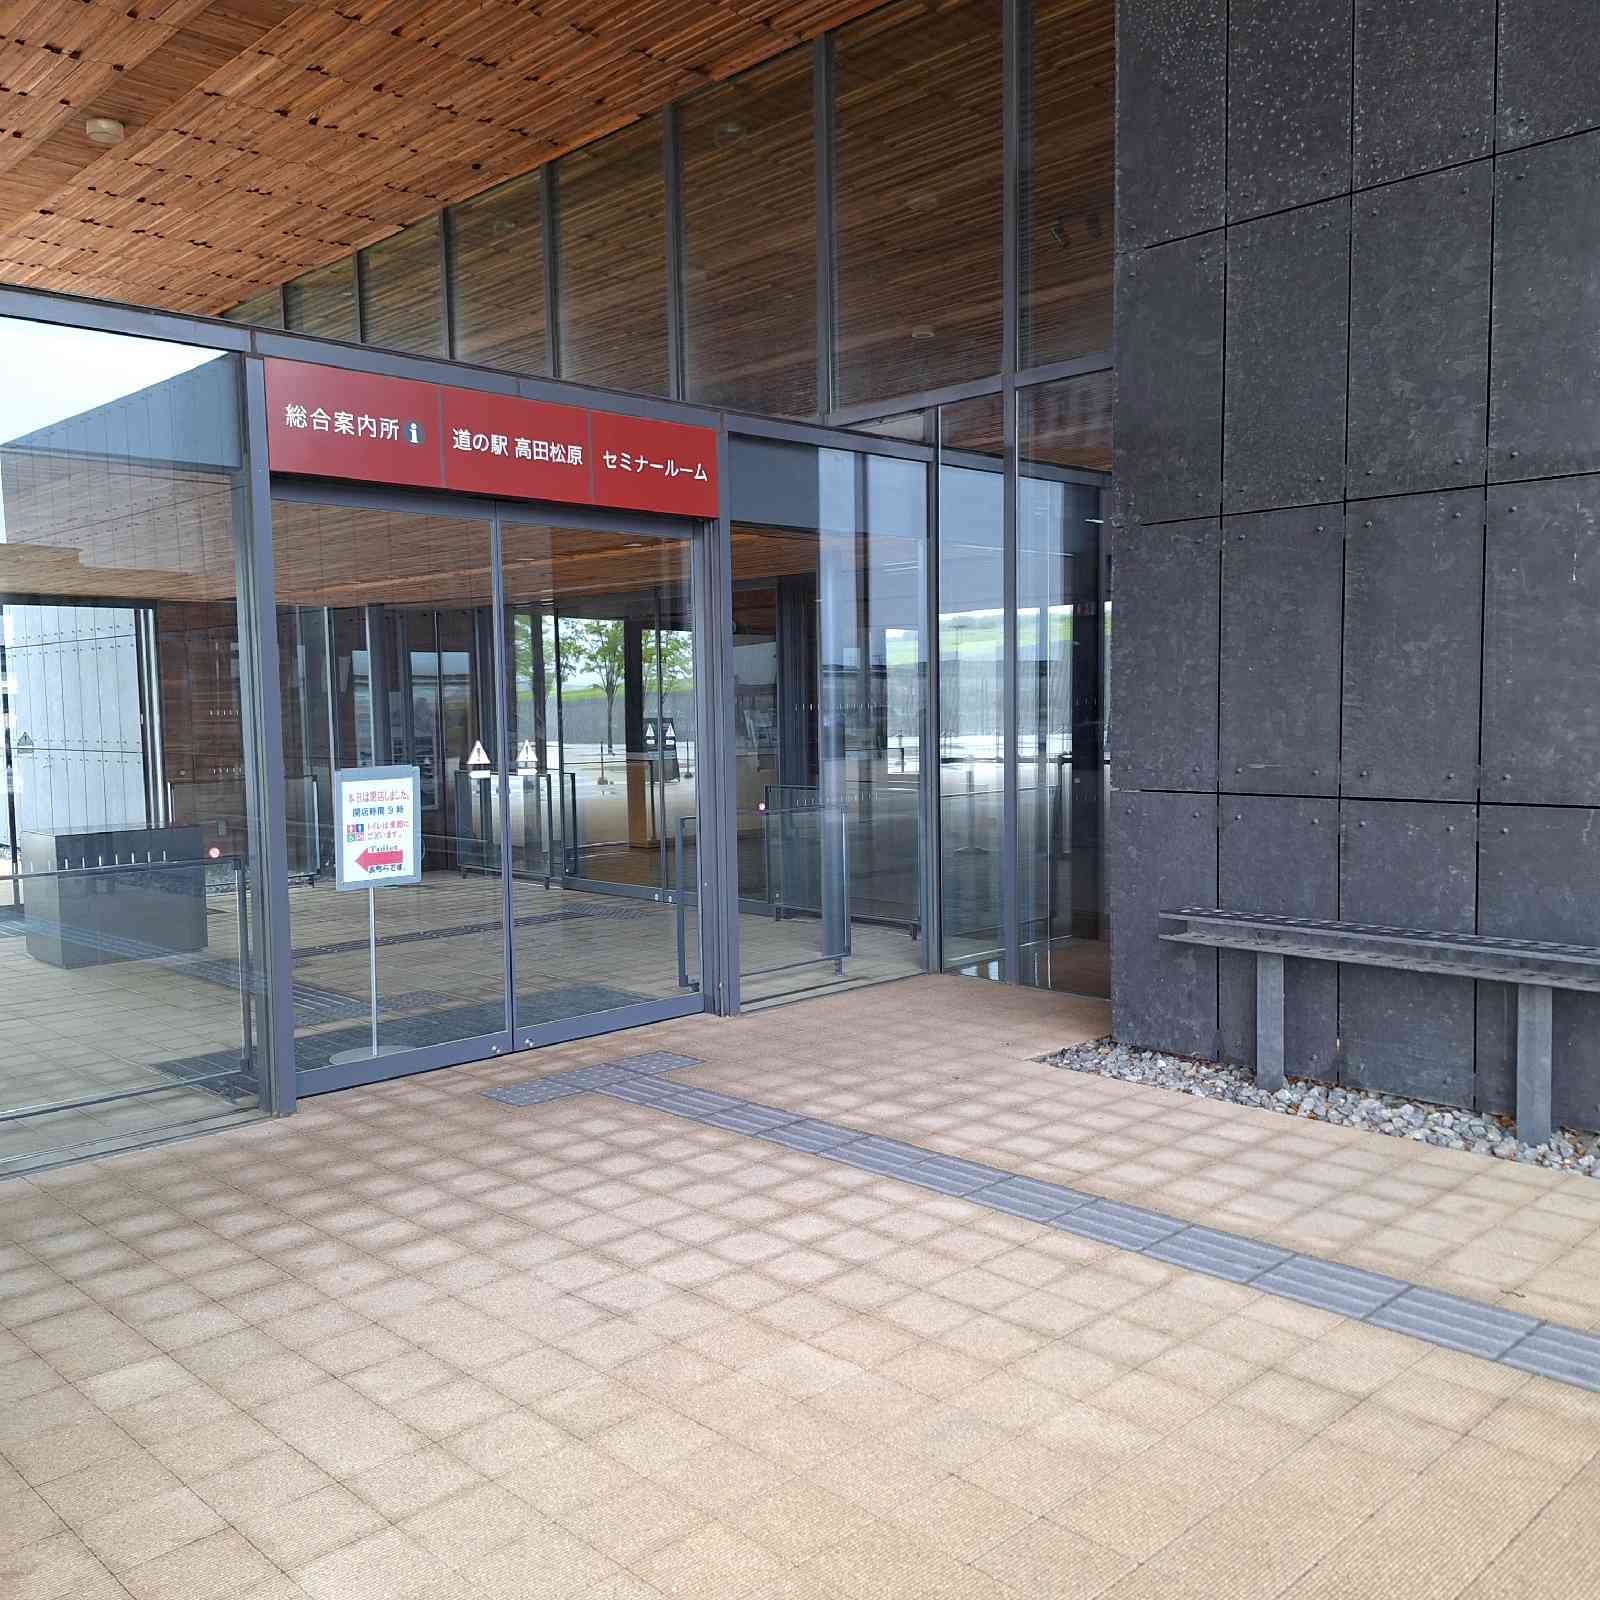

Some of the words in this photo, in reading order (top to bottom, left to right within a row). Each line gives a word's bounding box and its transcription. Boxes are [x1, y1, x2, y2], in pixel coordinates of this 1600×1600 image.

[284, 403, 400, 441] 総合案内所
[452, 428, 509, 457] 道の駅
[514, 437, 583, 466] 高田松原
[602, 450, 708, 482] セミナールーム
